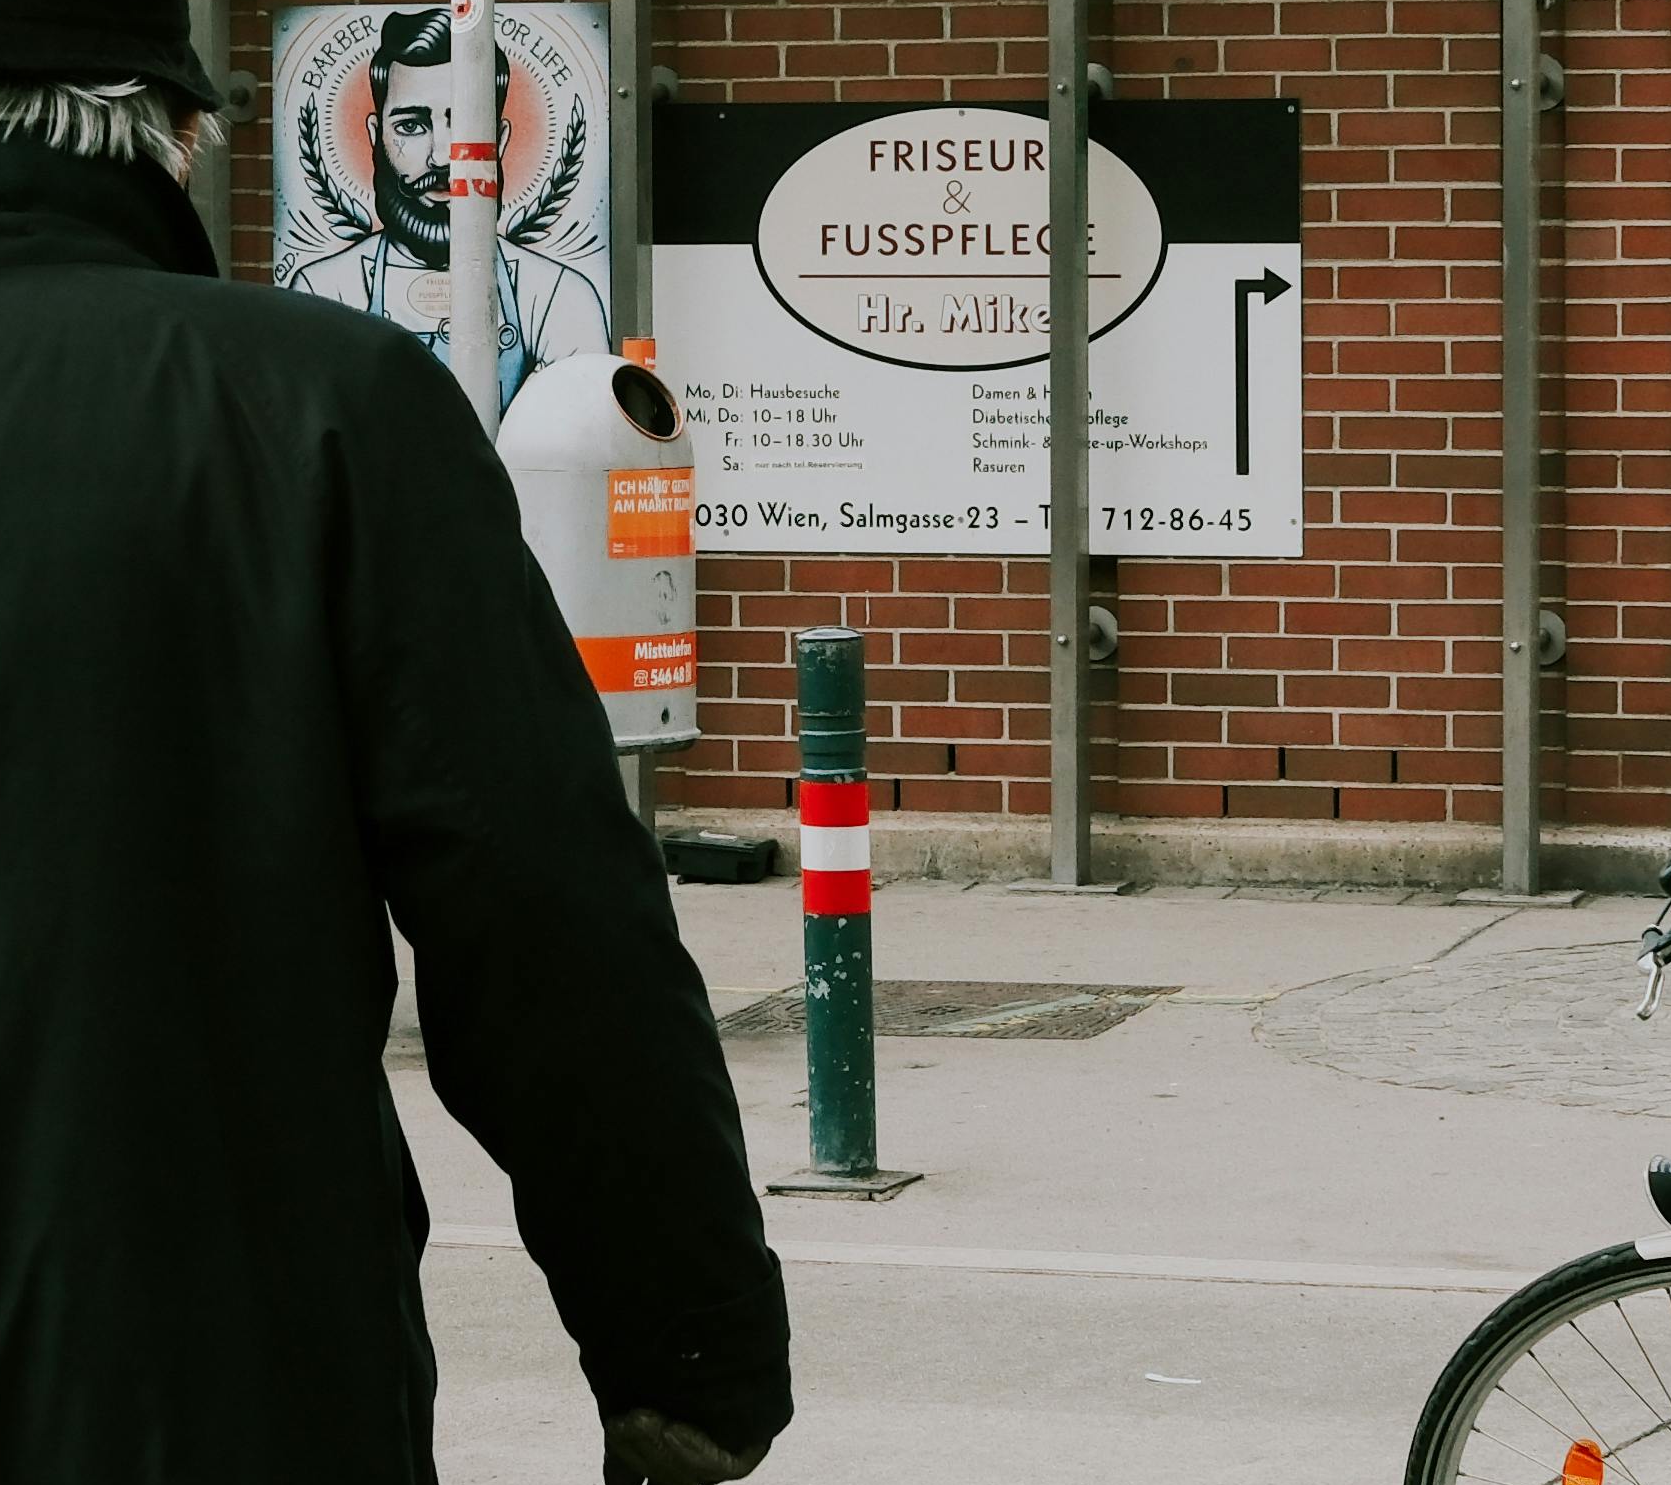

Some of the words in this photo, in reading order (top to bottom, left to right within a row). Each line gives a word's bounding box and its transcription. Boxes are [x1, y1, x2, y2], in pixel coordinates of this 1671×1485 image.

[301, 15, 380, 91] BARBER
[532, 37, 573, 88] LIFE
[869, 139, 1046, 172] FRISEUR
[942, 179, 972, 215] &
[857, 293, 925, 334] Hr.
[685, 383, 715, 401] Mo,
[750, 383, 841, 400] Hausbesuche
[972, 384, 1021, 400] Damen
[685, 407, 711, 424] Mi,
[717, 407, 744, 424] Do:
[811, 407, 837, 423] Uhr
[725, 432, 744, 448] Fr:
[839, 432, 865, 448] Uhr
[972, 433, 1037, 450] Schmink-
[723, 455, 745, 472] Sa:
[973, 458, 1026, 475] Rasuren
[614, 478, 636, 496] ICH
[614, 497, 635, 513] AM
[757, 501, 828, 531] Wien,
[840, 502, 955, 534] Salmgasse
[967, 506, 999, 530] 23
[1101, 507, 1253, 532] 712-86-45
[634, 638, 692, 661] Misttelefon
